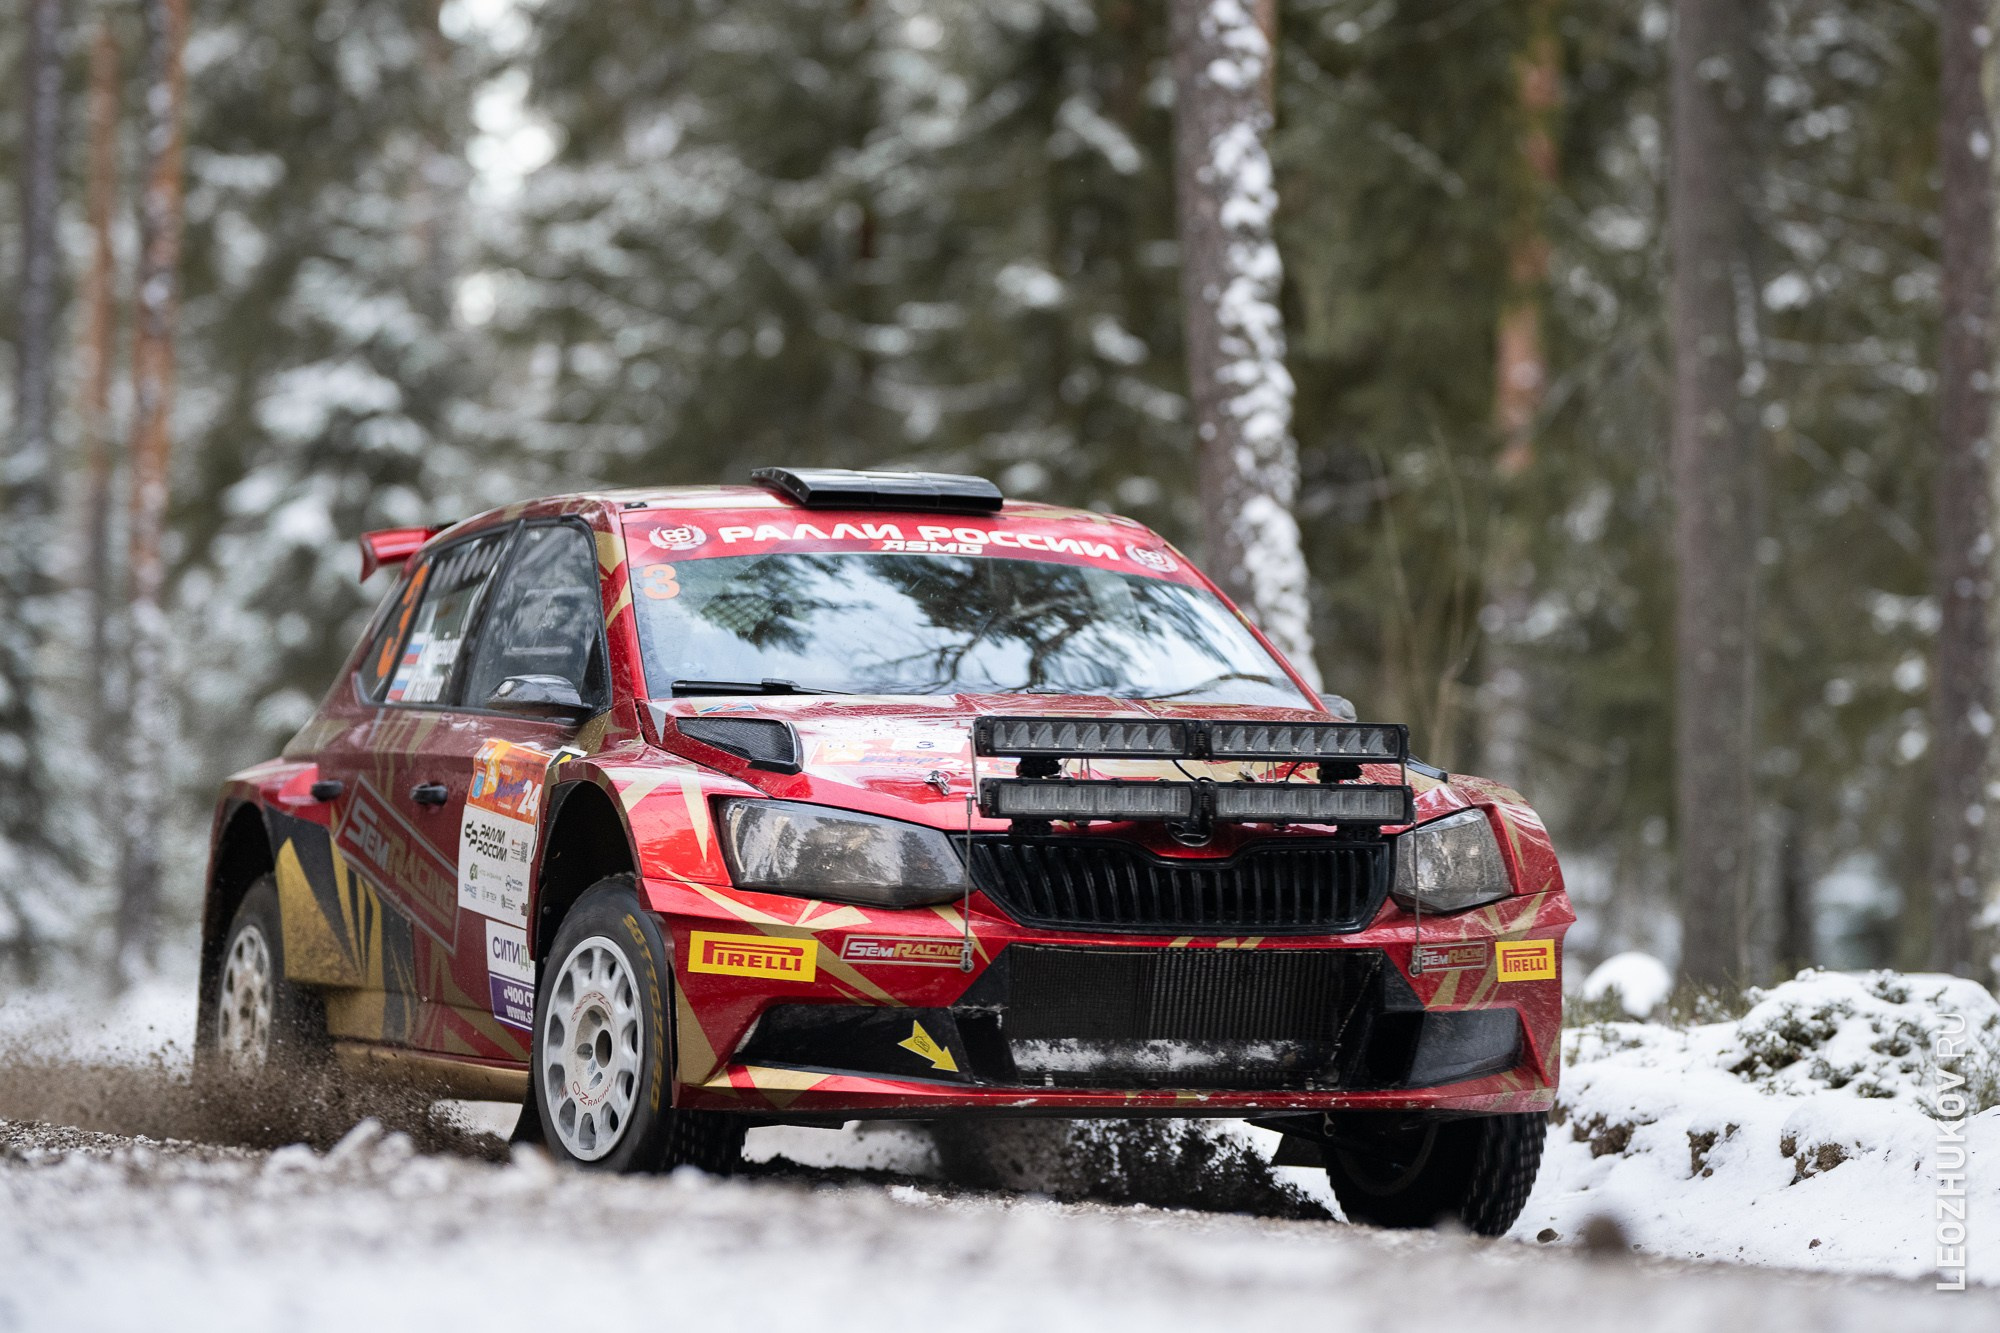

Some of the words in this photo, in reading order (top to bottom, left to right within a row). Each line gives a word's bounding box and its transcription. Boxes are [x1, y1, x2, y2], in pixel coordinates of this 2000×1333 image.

[718, 523, 904, 543] РАЛЛИ
[917, 525, 1120, 561] РОССИИ
[642, 564, 681, 600] 3
[916, 741, 935, 749] 3
[517, 779, 543, 817] 24
[479, 824, 506, 845] РАЛЛИ
[476, 840, 508, 862] РОССИИ
[492, 936, 531, 972] СИТИД
[702, 940, 804, 972] PIRELLI
[1502, 947, 1548, 973] PIRELLI
